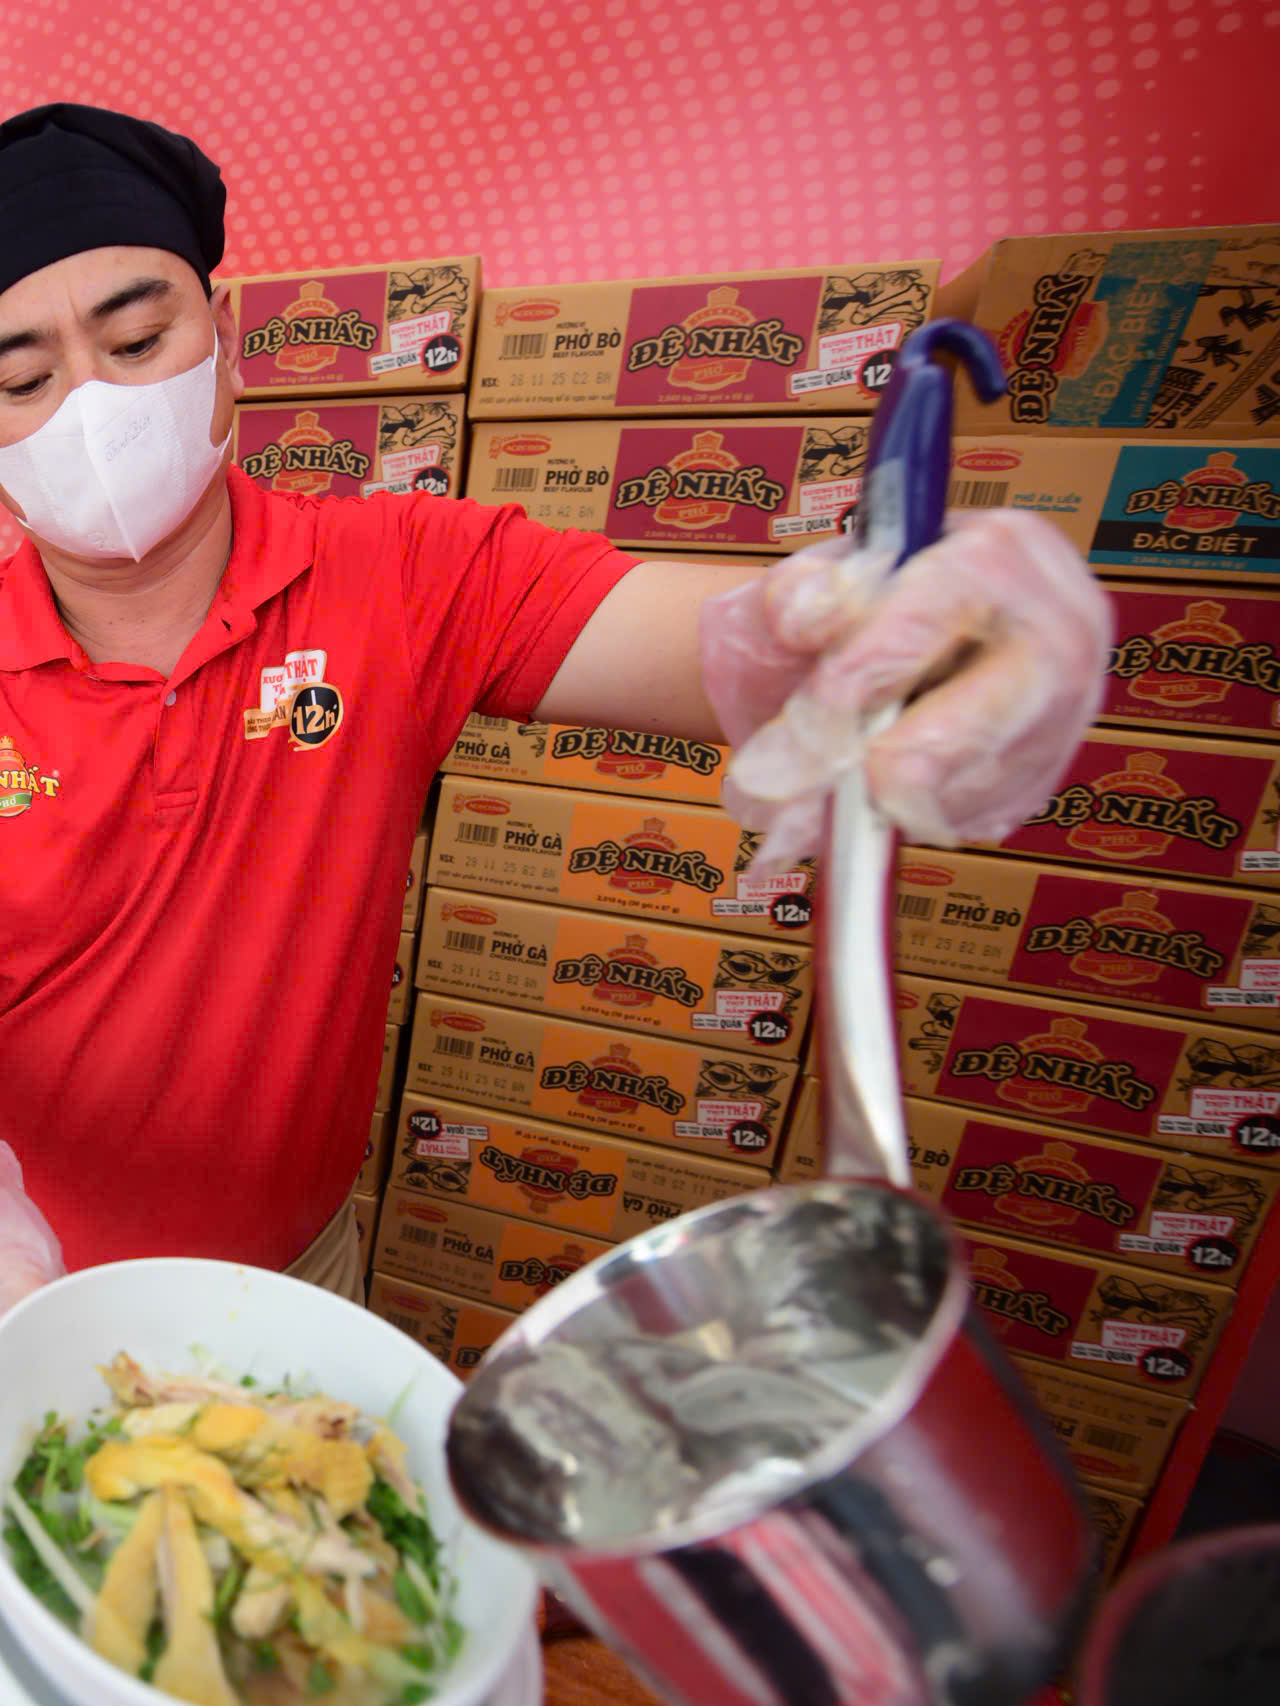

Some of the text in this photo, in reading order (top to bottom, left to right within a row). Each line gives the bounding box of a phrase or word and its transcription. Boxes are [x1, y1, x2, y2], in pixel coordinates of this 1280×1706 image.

[243, 309, 379, 359] ĐỆ NHẤT
[555, 327, 621, 350] PHỞ BÒ
[626, 319, 805, 372] ĐỆ NHẤT
[425, 346, 458, 369] 12h
[863, 363, 892, 388] 12
[1007, 366, 1058, 424] ĐỆ
[241, 439, 373, 480] ĐỆ NHẤT
[545, 465, 609, 486] PHỞ BÒ
[616, 464, 787, 511] ĐỆ NHẤT
[1124, 480, 1178, 514] ĐỆ
[1132, 529, 1258, 557] ĐẶC BIỆT
[285, 655, 318, 683] THẬT
[294, 704, 336, 736] 12h
[455, 737, 512, 761] PHỞ GÀ
[1094, 791, 1242, 850] NHẤT
[504, 828, 563, 851] PHỞ GÀ
[568, 840, 724, 894] ĐỆ NHẤT
[774, 902, 810, 922] 12h
[943, 902, 1021, 928] PHỞ BÒ
[491, 938, 548, 962] PHỞ GÀ
[1025, 917, 1094, 955] ĐỆ
[1094, 923, 1225, 979] NHẤT
[552, 953, 703, 1008] ĐỆ NHẤT
[751, 1021, 788, 1040] 12h
[480, 1045, 535, 1067] PHỞ GÀ
[540, 1061, 686, 1115] ĐỆ NHẤT
[951, 1043, 1157, 1112] ĐỆ NHẤT
[733, 1131, 767, 1148] 12h
[479, 1145, 570, 1194] NHẤT
[923, 1148, 951, 1168] BÒ
[568, 1170, 620, 1200] ĐỆ
[953, 1162, 1137, 1227] ĐỆ NHẤT
[475, 1242, 495, 1262] GÀ
[499, 1257, 545, 1286] ĐỆ
